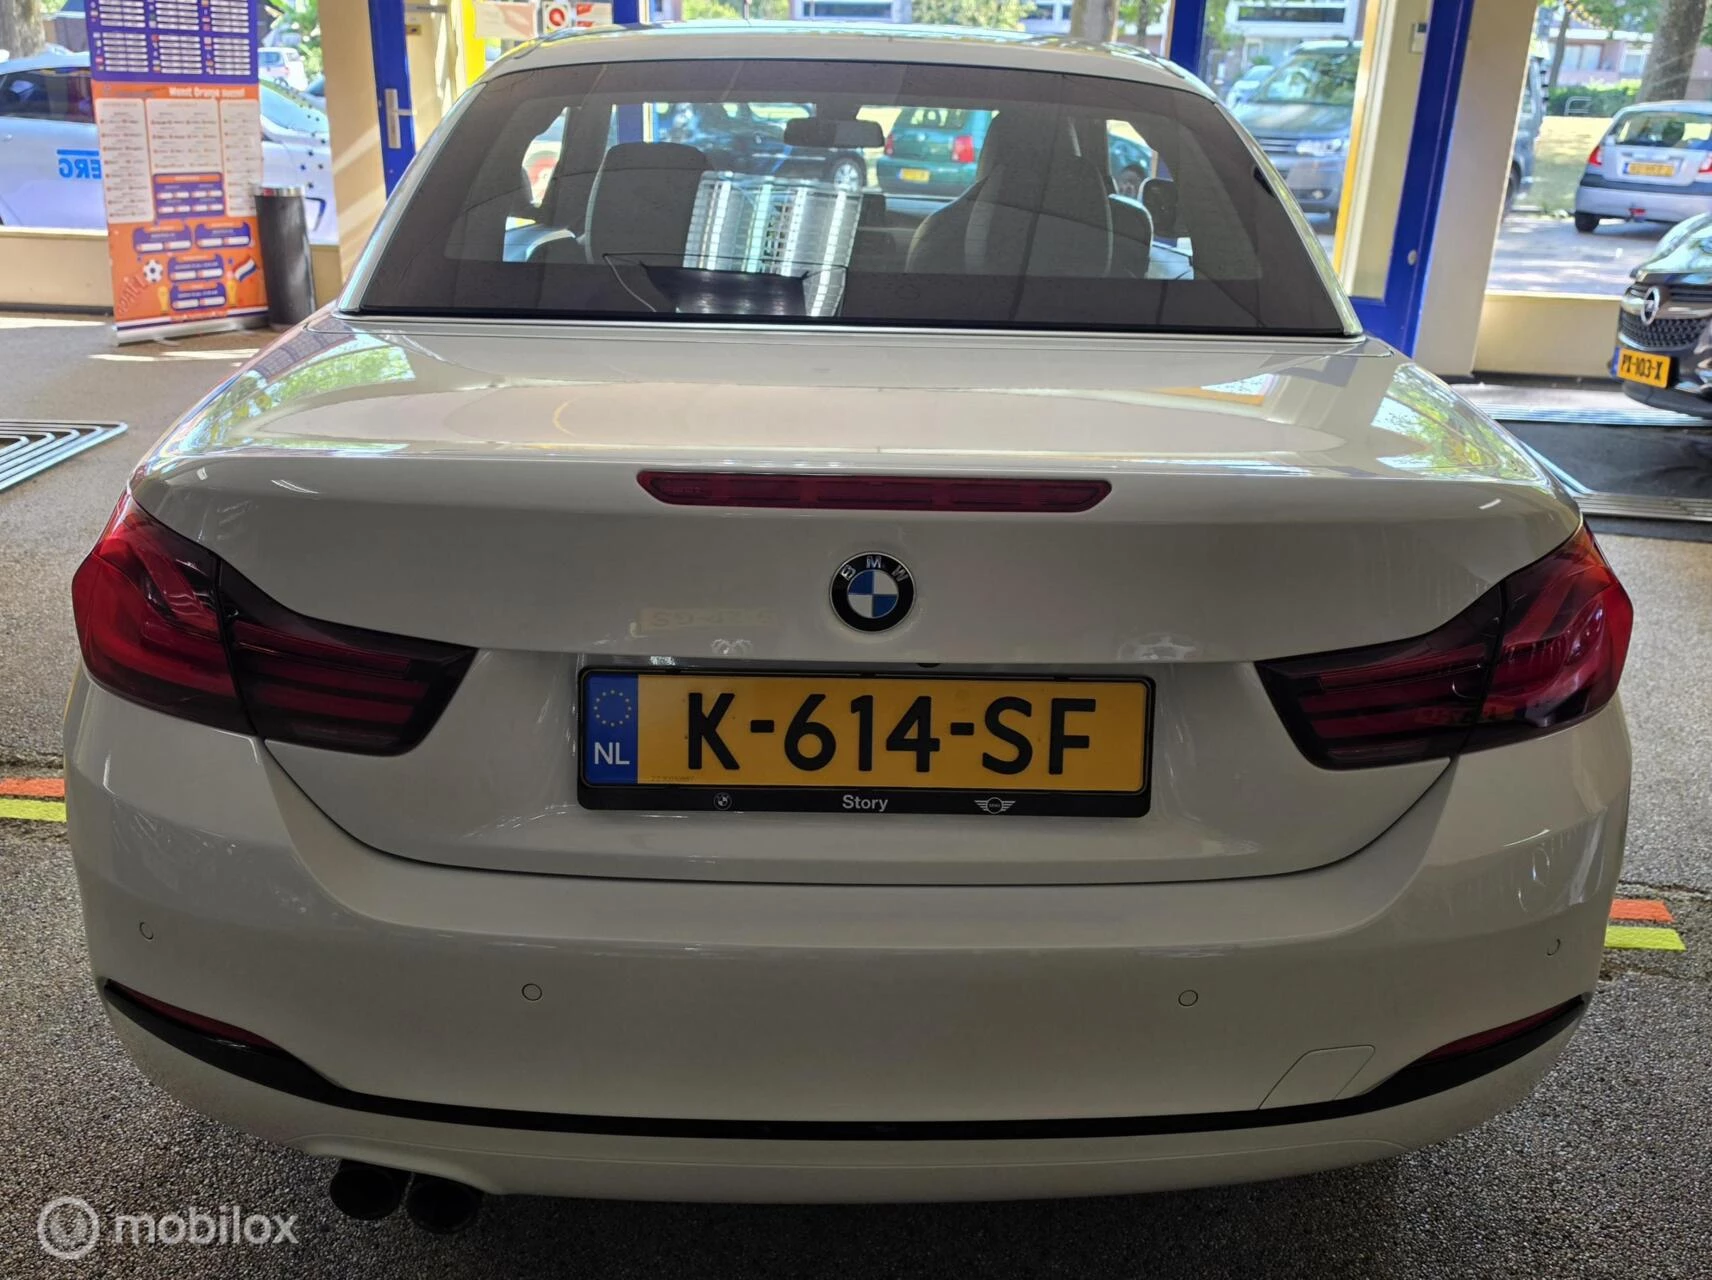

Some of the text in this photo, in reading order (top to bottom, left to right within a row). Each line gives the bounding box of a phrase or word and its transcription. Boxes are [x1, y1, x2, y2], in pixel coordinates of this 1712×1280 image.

[841, 555, 909, 582] BMW
[687, 692, 1097, 776] K-614-SF
[594, 742, 630, 765] NL
[842, 794, 889, 812] Story
